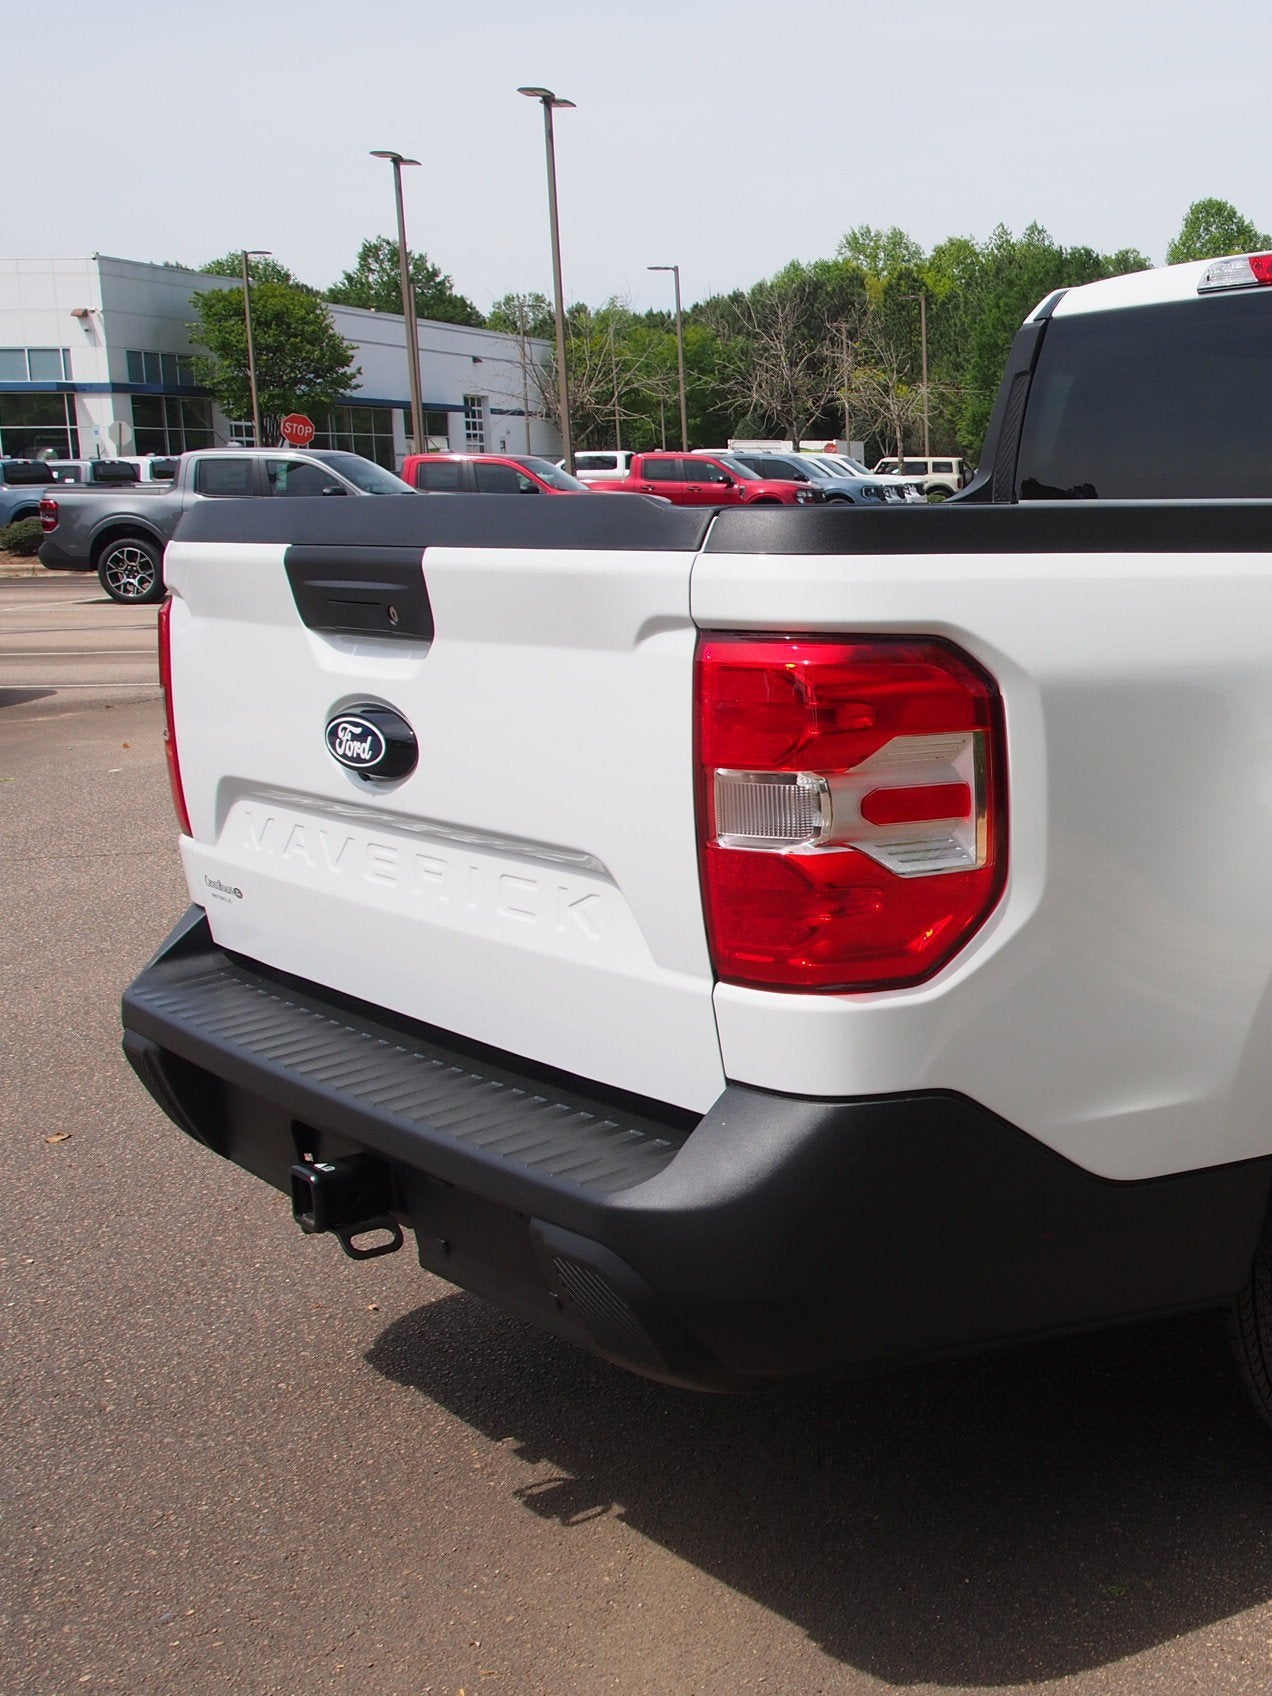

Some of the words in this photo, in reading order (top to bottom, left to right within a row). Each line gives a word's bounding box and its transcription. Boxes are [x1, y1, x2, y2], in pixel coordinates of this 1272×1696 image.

[284, 421, 312, 437] STOP
[335, 723, 372, 760] Ford
[242, 810, 603, 942] MAVERICK
